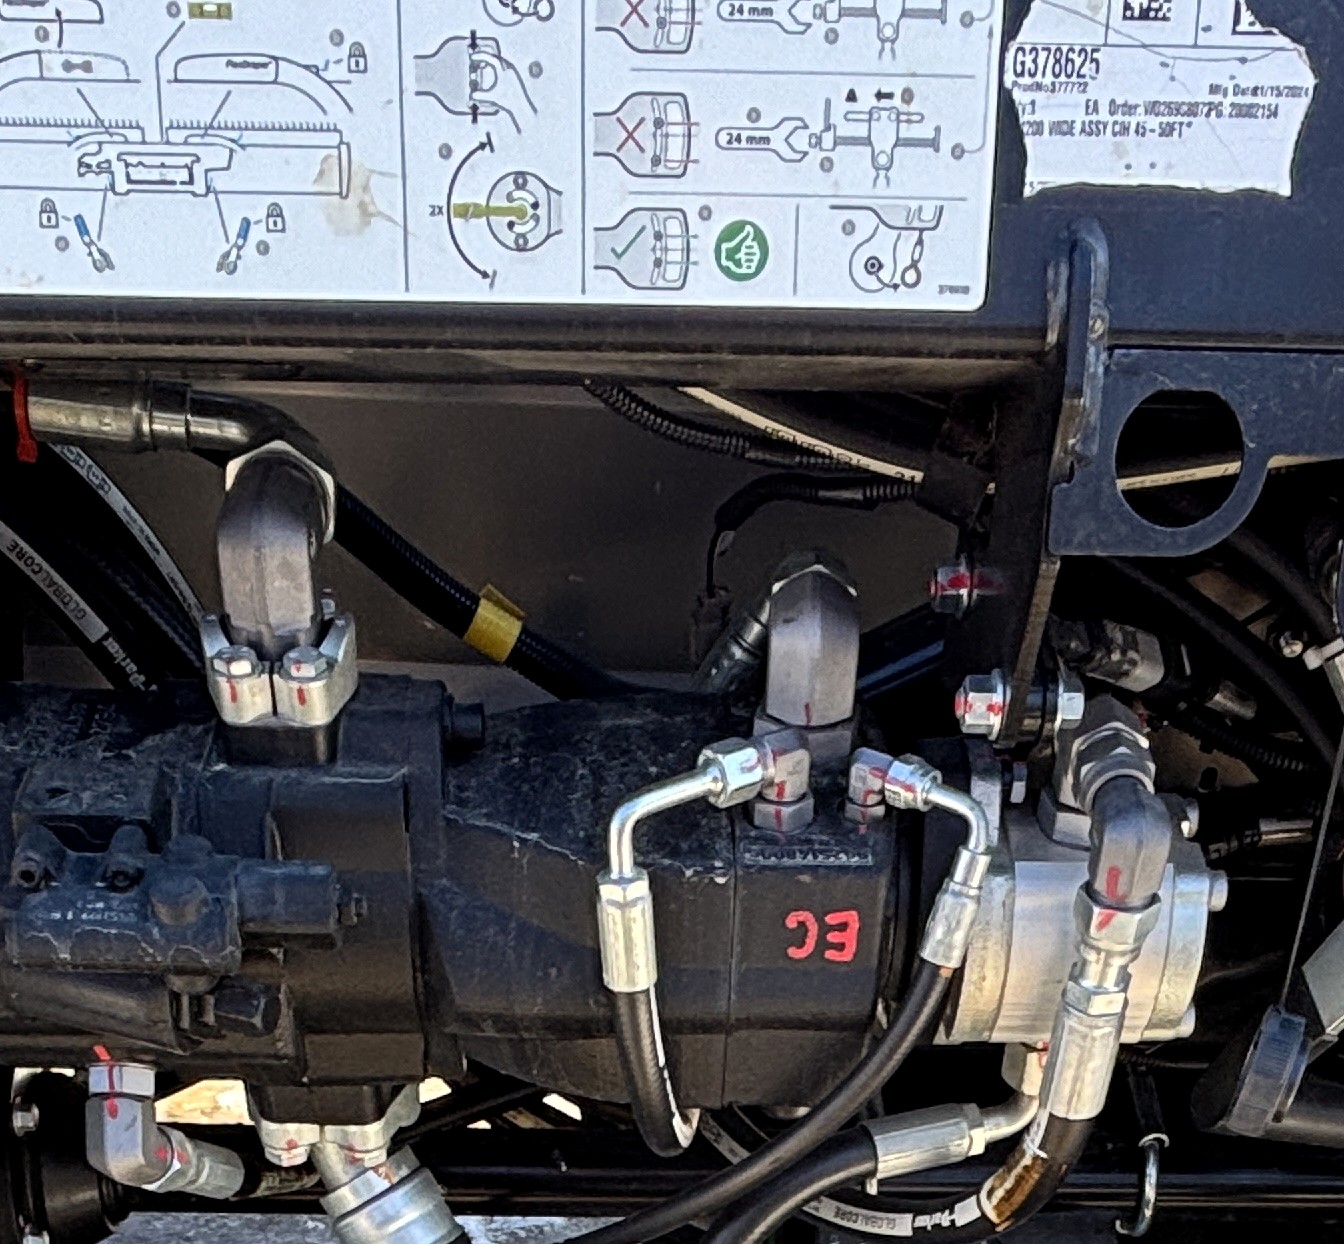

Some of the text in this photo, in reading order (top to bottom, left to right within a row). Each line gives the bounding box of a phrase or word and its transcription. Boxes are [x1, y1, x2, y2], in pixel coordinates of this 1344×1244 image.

[728, 4, 774, 16] 24 mm
[1012, 46, 1102, 81] G378625
[725, 134, 771, 146] 24 mm
[8, 538, 87, 621] GLOBALCORE
